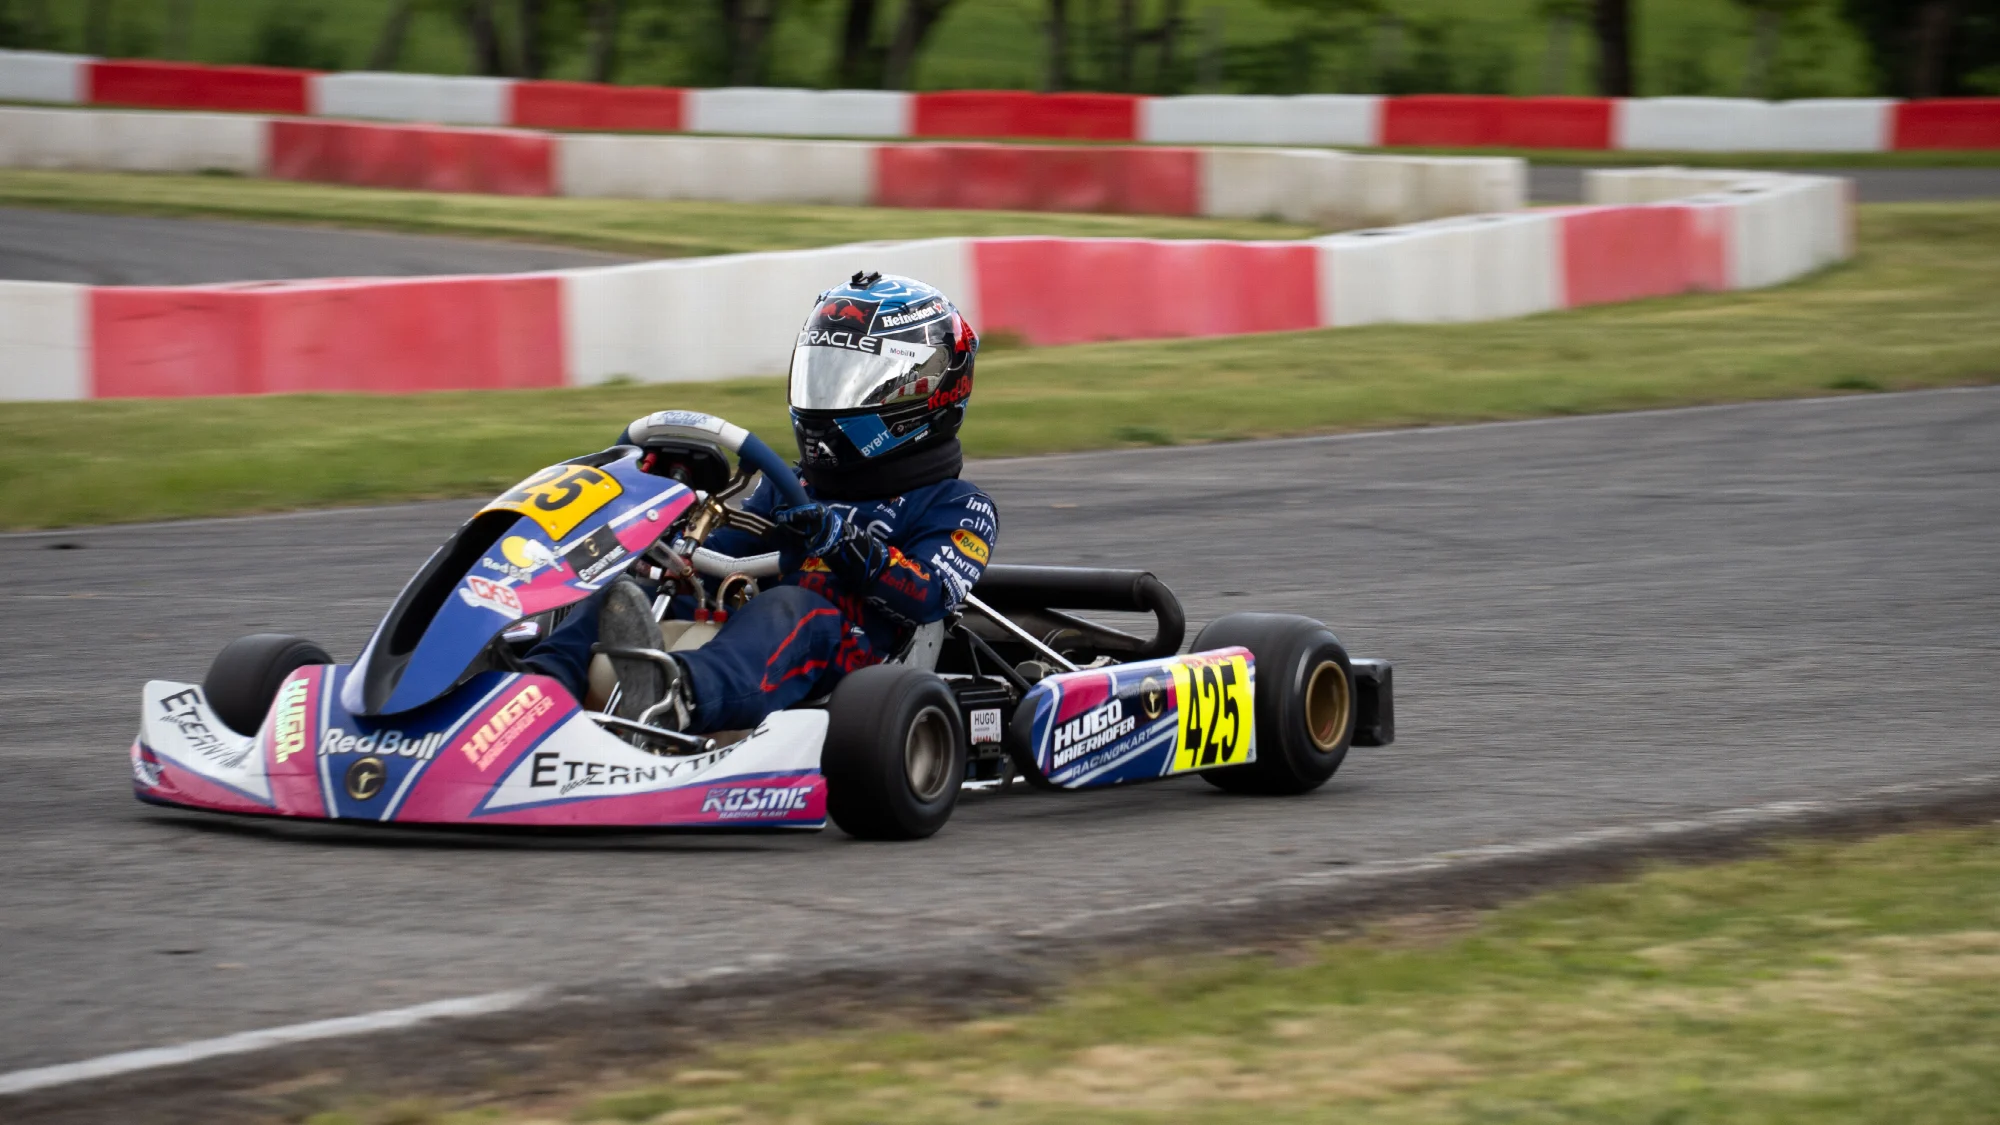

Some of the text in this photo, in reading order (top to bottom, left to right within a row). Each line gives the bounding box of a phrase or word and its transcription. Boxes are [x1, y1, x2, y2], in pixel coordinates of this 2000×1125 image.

[882, 306, 936, 328] Heineken
[797, 330, 877, 353] ORACLE
[889, 346, 909, 357] Mobil
[927, 386, 960, 411] Red
[861, 427, 891, 457] BYBIT
[459, 684, 544, 757] HUGO
[974, 712, 995, 725] HUGO
[1053, 698, 1123, 752] HUGO
[1184, 664, 1240, 768] 425
[317, 728, 444, 761] Red Bull
[1053, 715, 1136, 770] MAIERHOFER
[1071, 729, 1152, 778] RACING KART
[701, 785, 814, 814] KOSMIC
